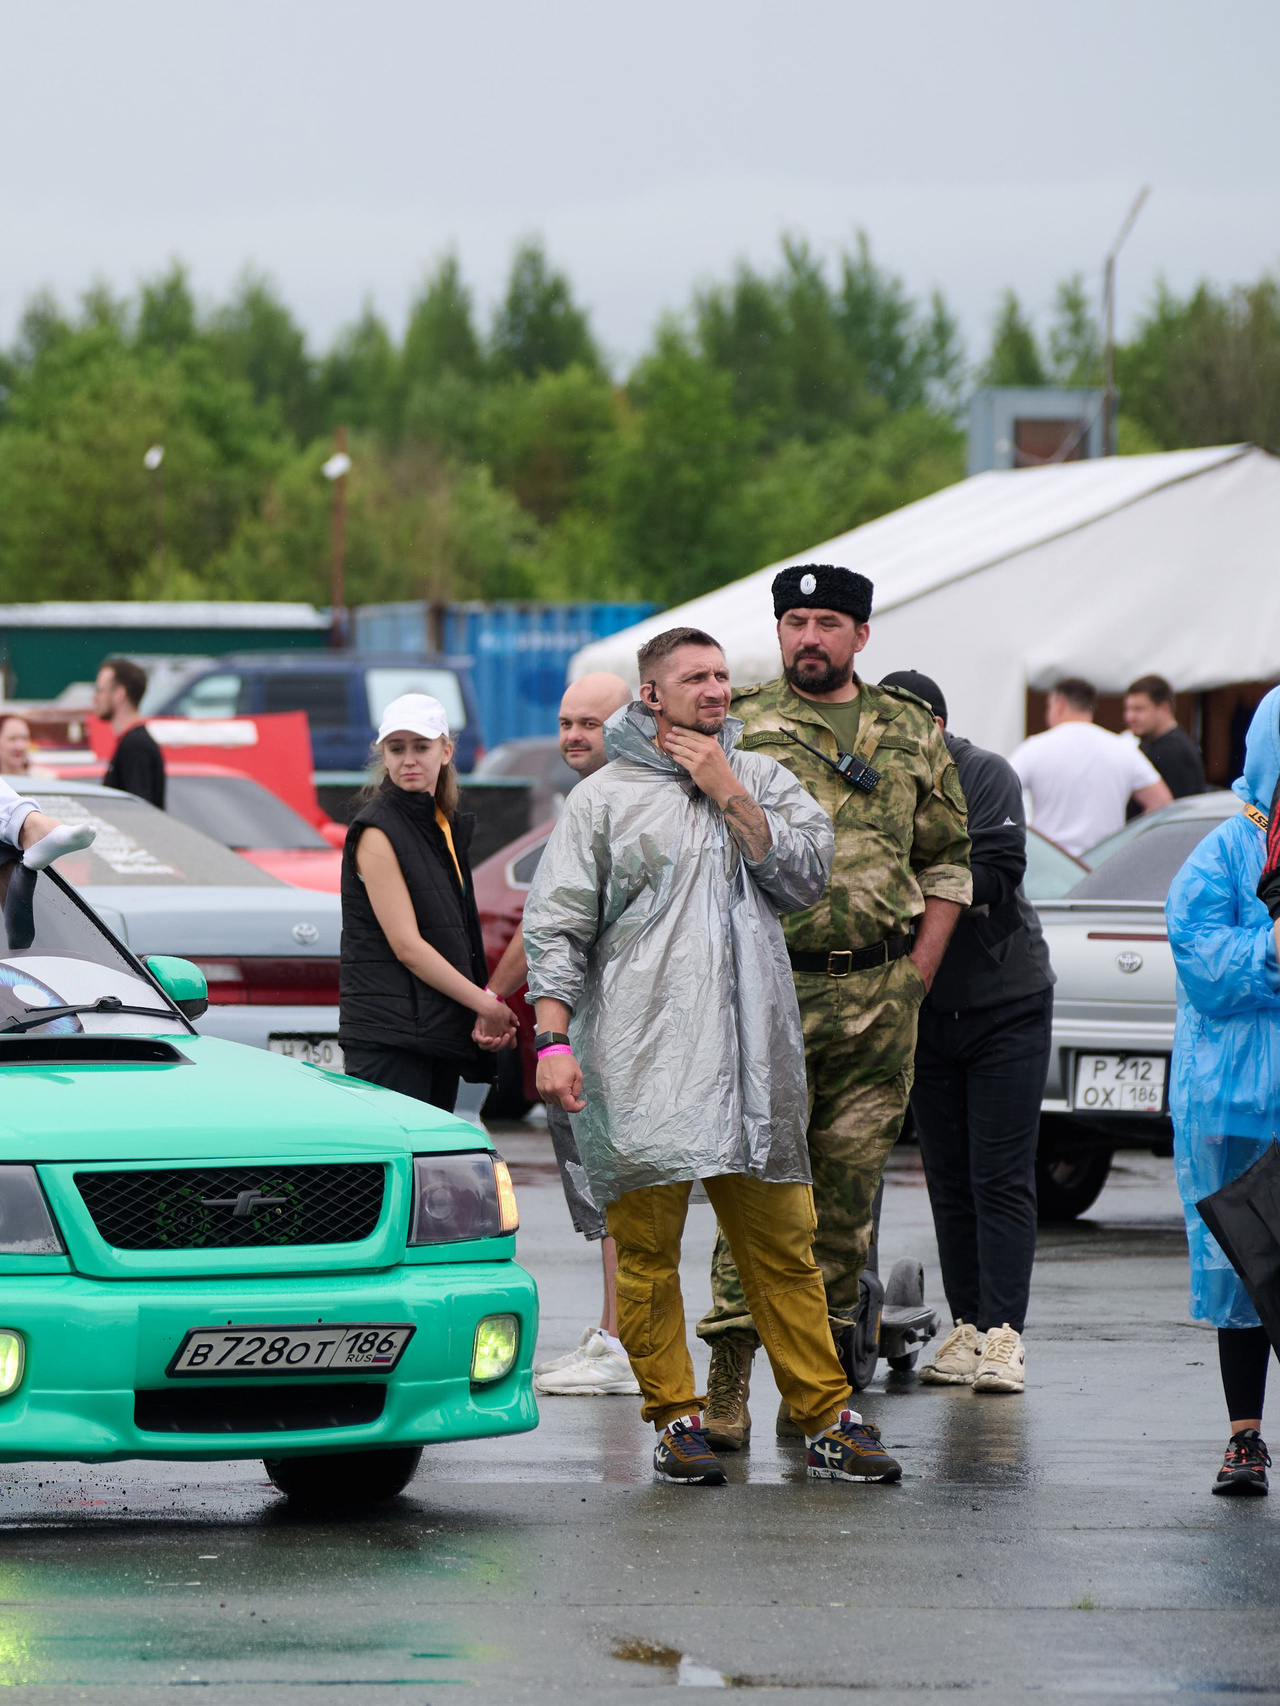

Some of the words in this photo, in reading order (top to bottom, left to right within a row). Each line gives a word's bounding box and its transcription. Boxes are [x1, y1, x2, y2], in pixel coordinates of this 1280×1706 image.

[1115, 1060, 1152, 1080] 212
[1129, 1086, 1158, 1103] 186
[345, 1331, 397, 1354] 186
[345, 1353, 372, 1363] RUS
